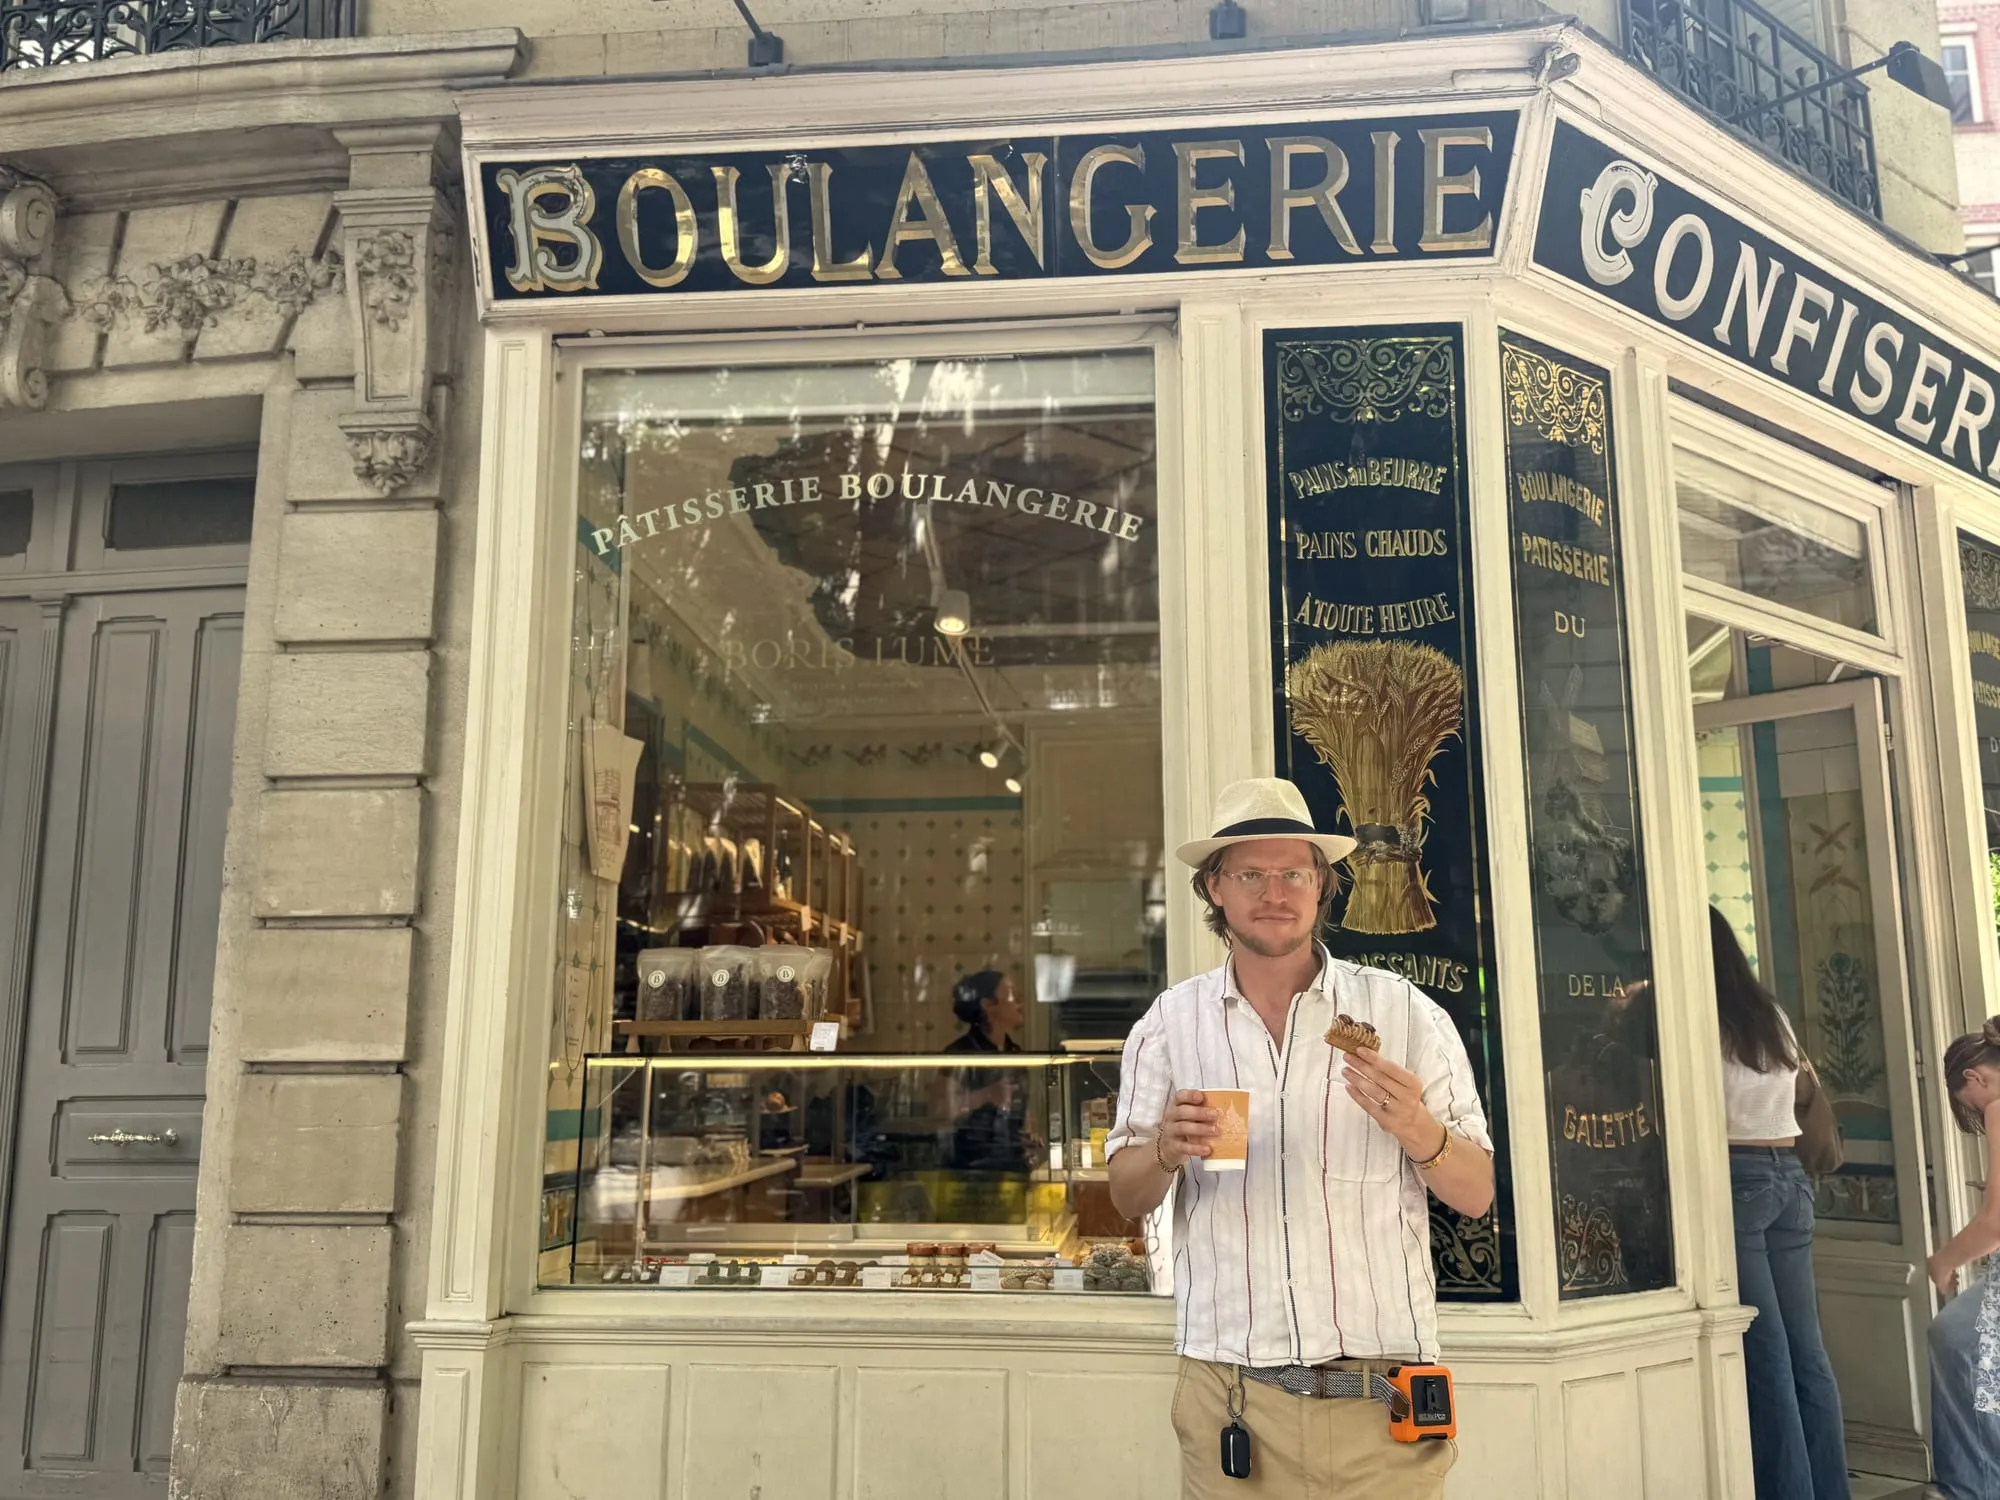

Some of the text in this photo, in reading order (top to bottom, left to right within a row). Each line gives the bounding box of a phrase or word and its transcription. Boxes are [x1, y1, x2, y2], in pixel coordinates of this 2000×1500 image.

[496, 126, 1494, 291] BOULANGERIE
[1580, 160, 2000, 482] CONFISER
[1288, 460, 1349, 499] PAINS
[1367, 457, 1448, 495] BEURRE
[1516, 471, 1605, 528] BOULANGERIE
[591, 473, 1144, 556] PÂTISSERIE BOULANGERIE
[1295, 529, 1448, 560] PAINS CHAUDS
[1521, 532, 1610, 587] PATISSERIE
[1312, 599, 1375, 634] TOUTE
[1378, 591, 1456, 633] HEURE
[1554, 610, 1586, 638] DU
[726, 637, 855, 670] BORIS
[1568, 974, 1626, 998] DE LA
[1563, 1102, 1650, 1148] GALETTE
